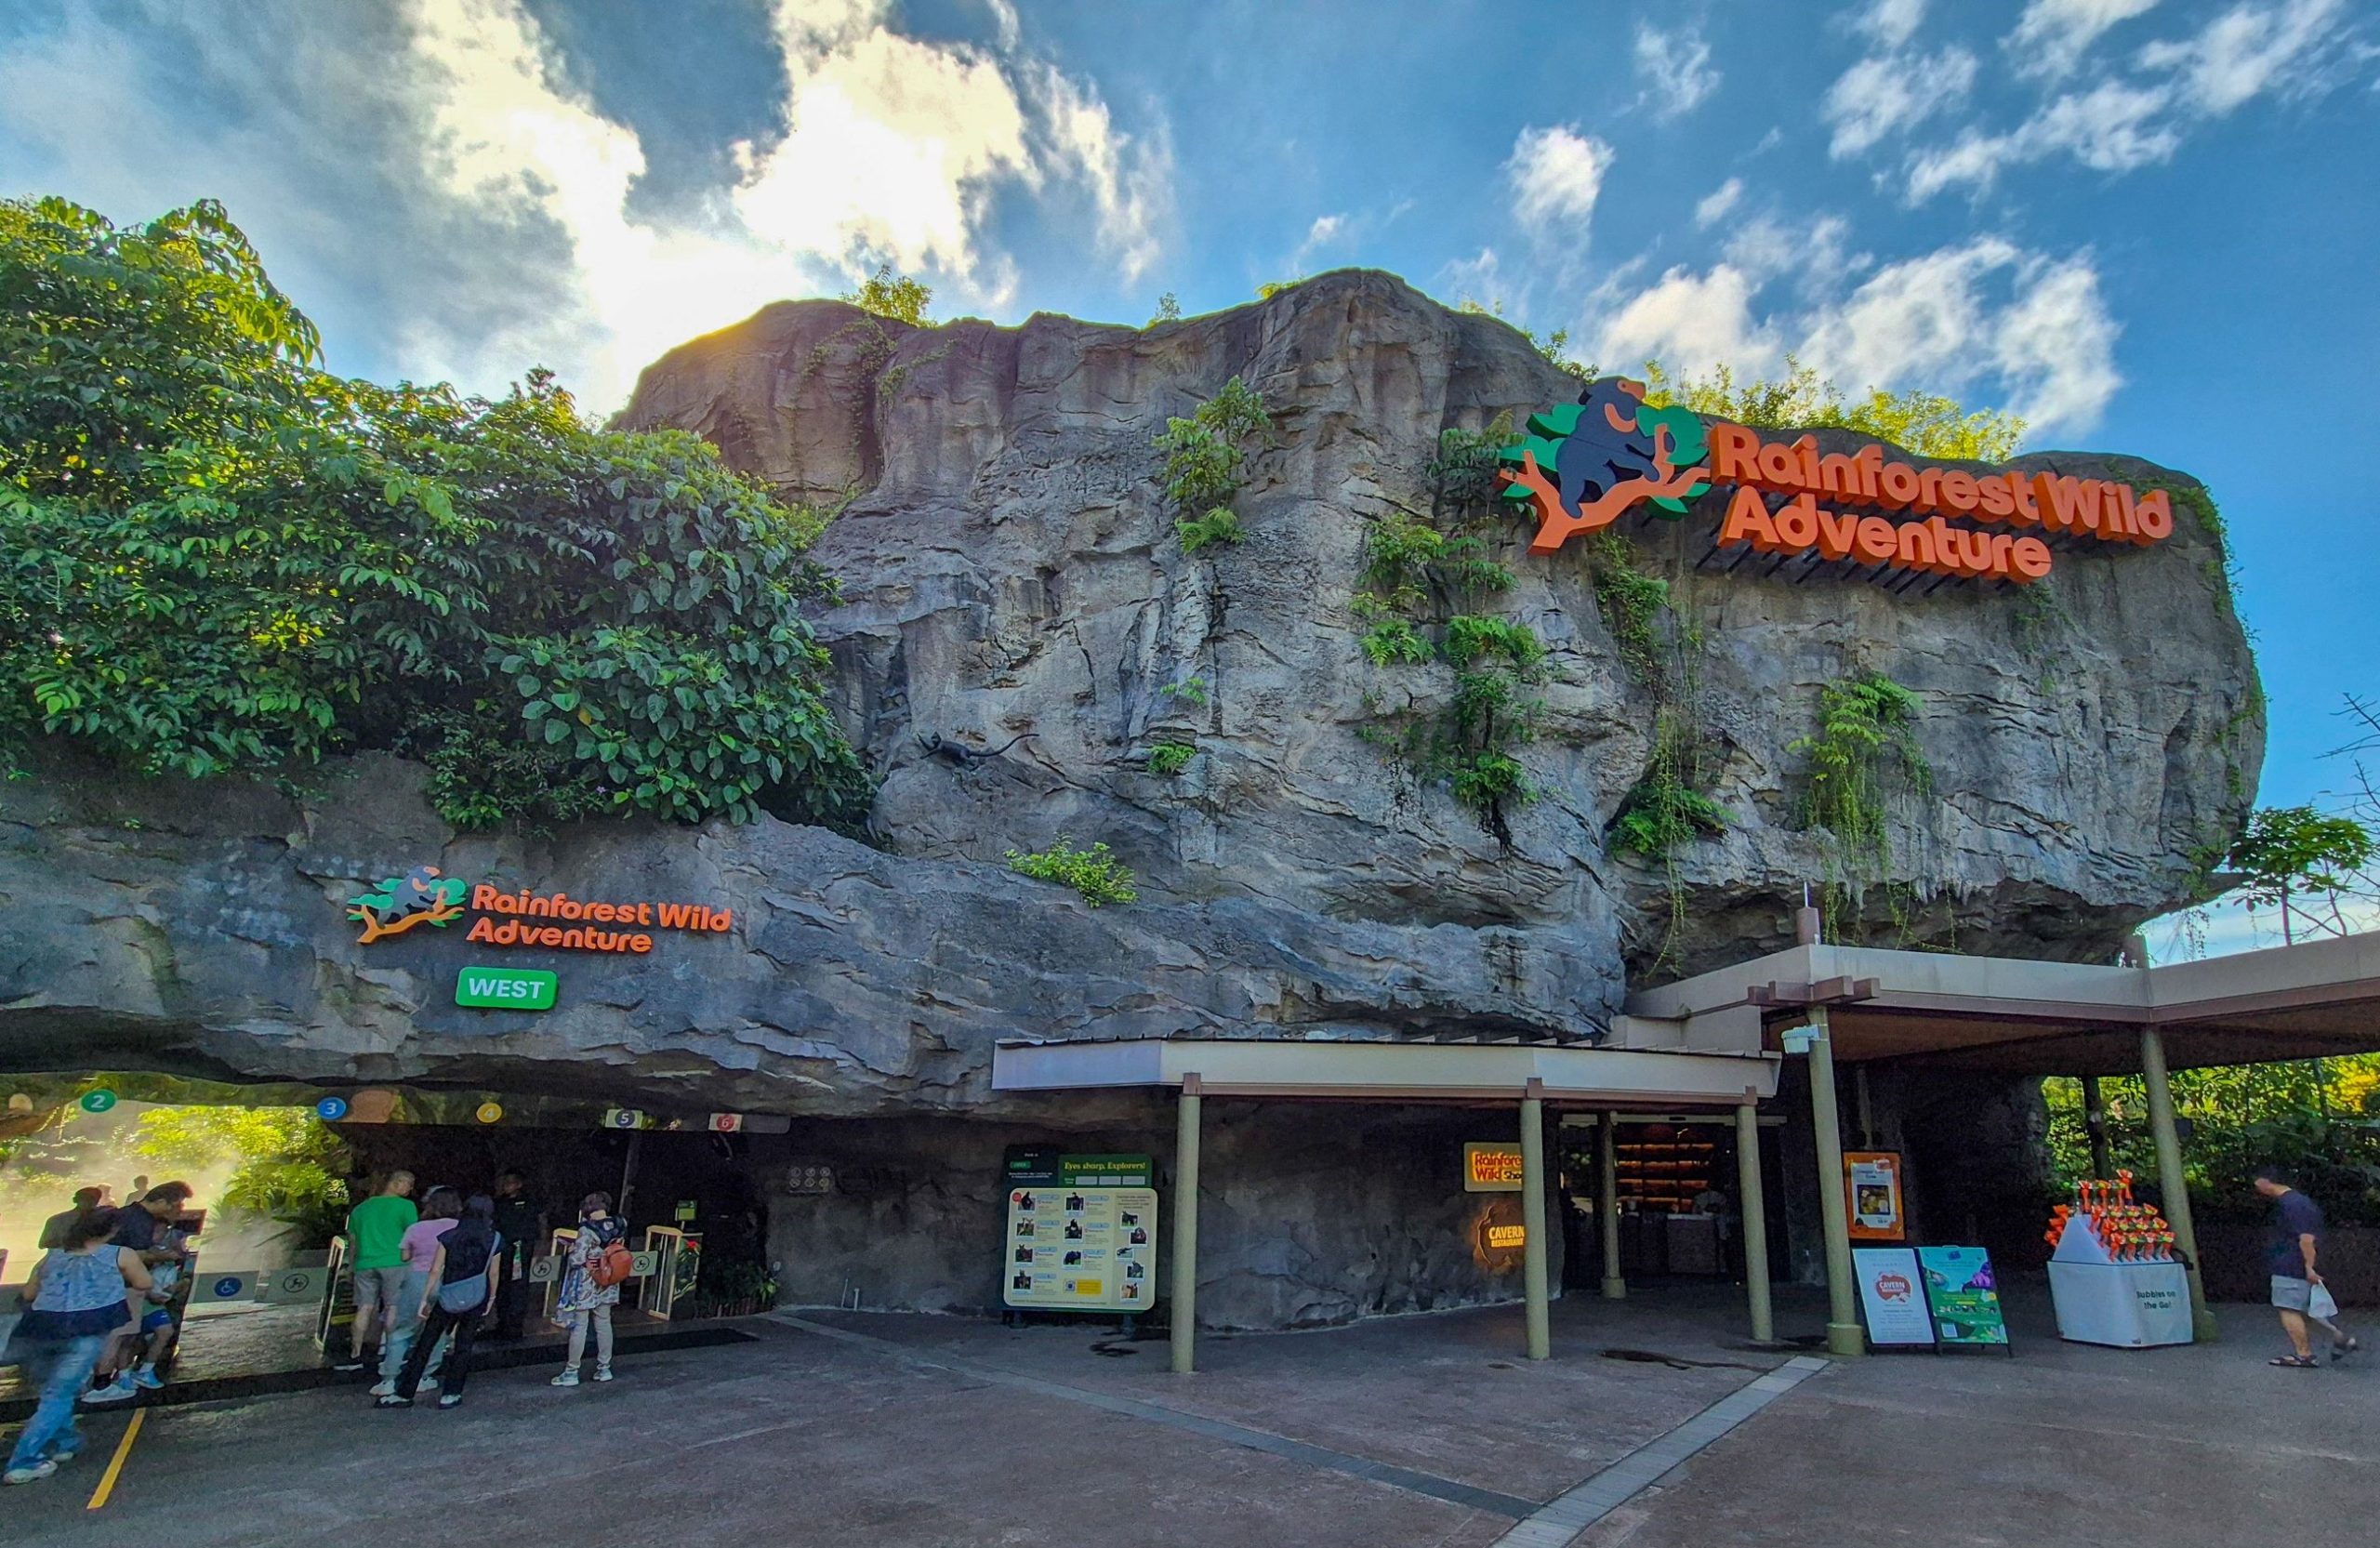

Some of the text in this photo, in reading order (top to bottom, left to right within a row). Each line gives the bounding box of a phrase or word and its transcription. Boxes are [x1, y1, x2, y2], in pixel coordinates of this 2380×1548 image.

[1710, 424, 2173, 544] Rainforest Wild
[1718, 485, 2052, 583] Adventure
[471, 884, 732, 932] Rainforest Wild
[466, 917, 652, 953] Adventure
[468, 977, 545, 999] WEST
[91, 1095, 105, 1109] 2
[325, 1103, 337, 1115] 3
[620, 1113, 629, 1124] 5
[721, 1118, 731, 1129] 6
[1064, 1162, 1080, 1171] Eyes
[1107, 1162, 1146, 1171] Explorers!
[1474, 1153, 1523, 1167] Rainfore
[1474, 1168, 1501, 1181] Wild
[1488, 1225, 1525, 1239] CAVERN
[1879, 1281, 1906, 1290] CAVERN
[2144, 1302, 2157, 1310] the
